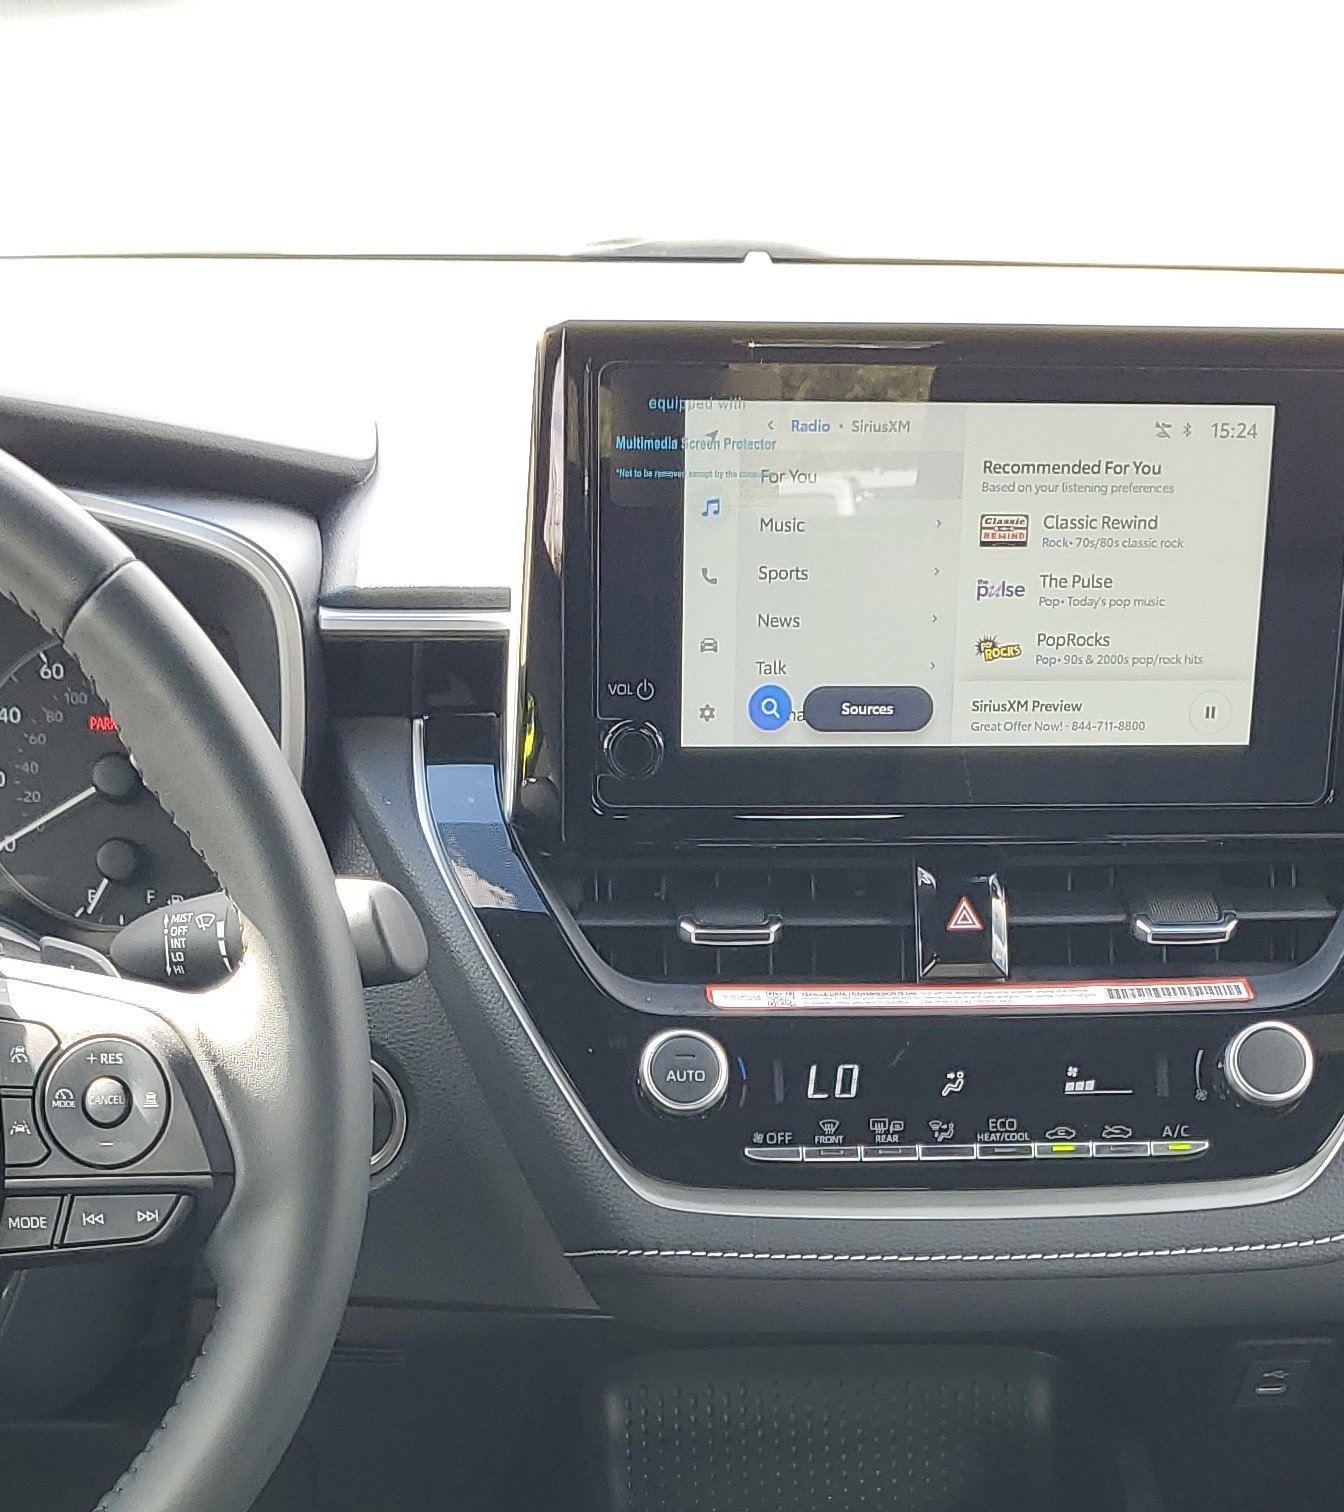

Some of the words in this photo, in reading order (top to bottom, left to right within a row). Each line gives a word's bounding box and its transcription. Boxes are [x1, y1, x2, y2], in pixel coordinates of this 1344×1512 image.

[791, 419, 831, 433] Radio
[851, 420, 911, 434] SiriusXM
[1210, 422, 1258, 439] 15:24
[982, 459, 1101, 476] Recommended
[1105, 460, 1129, 476] For
[1133, 460, 1162, 476] You
[760, 469, 786, 484] For
[789, 469, 817, 485] You
[982, 481, 1015, 494] Based
[1018, 484, 1033, 494] on
[1034, 484, 1059, 497] your
[1061, 482, 1108, 497] listening
[1111, 482, 1175, 497] preferences
[759, 517, 806, 533] Music
[1042, 514, 1098, 530] Classic
[1102, 514, 1158, 531] Rewind
[1075, 536, 1120, 549] 70s/80s
[1122, 537, 1157, 549] classic
[1160, 537, 1184, 549] rock
[758, 566, 808, 584] Sports
[1040, 574, 1069, 589] The
[1072, 574, 1113, 589] Pulse
[976, 580, 1026, 602] pulse
[1067, 596, 1106, 609] Today's
[1109, 598, 1131, 610] pop
[1134, 596, 1166, 608] music
[758, 614, 800, 628] News
[1036, 633, 1110, 651] PopRocks
[1064, 654, 1084, 666] 90s
[1085, 654, 1095, 666] &
[1097, 654, 1129, 666] 2000s
[1132, 654, 1182, 668] pop/rock
[1185, 654, 1204, 666] hits
[40, 664, 64, 680] 60
[756, 661, 787, 676] Talk
[608, 683, 633, 696] VOL
[65, 692, 88, 705] 100
[841, 702, 894, 716] Sources
[971, 699, 1028, 713] SiriusXM
[1032, 699, 1083, 713] Preview
[46, 711, 64, 723] 80
[970, 721, 1002, 733] Great
[1004, 720, 1032, 733] Offer
[1035, 721, 1063, 732] Now!
[1071, 720, 1146, 732] 844-711-8800
[29, 733, 47, 746] 60
[22, 762, 39, 774] 40
[23, 791, 41, 803] 20
[146, 890, 156, 904] F
[171, 912, 194, 925] MIST
[170, 926, 188, 937] OFF
[170, 938, 186, 949] INT
[171, 952, 184, 962] LO
[172, 964, 186, 975] HI
[100, 1052, 124, 1065] RES
[666, 1070, 706, 1082] AUTO
[807, 1063, 860, 1099] LO
[52, 1099, 76, 1108] MODE
[88, 1095, 124, 1106] CANCEL
[988, 1118, 1017, 1131] ECO
[766, 1132, 793, 1144] OFF
[977, 1132, 1030, 1142] HEAT/COOL
[1162, 1125, 1190, 1138] A/C
[814, 1135, 843, 1144] FRONT
[875, 1134, 899, 1144] REAR
[8, 1216, 48, 1229] MODE
